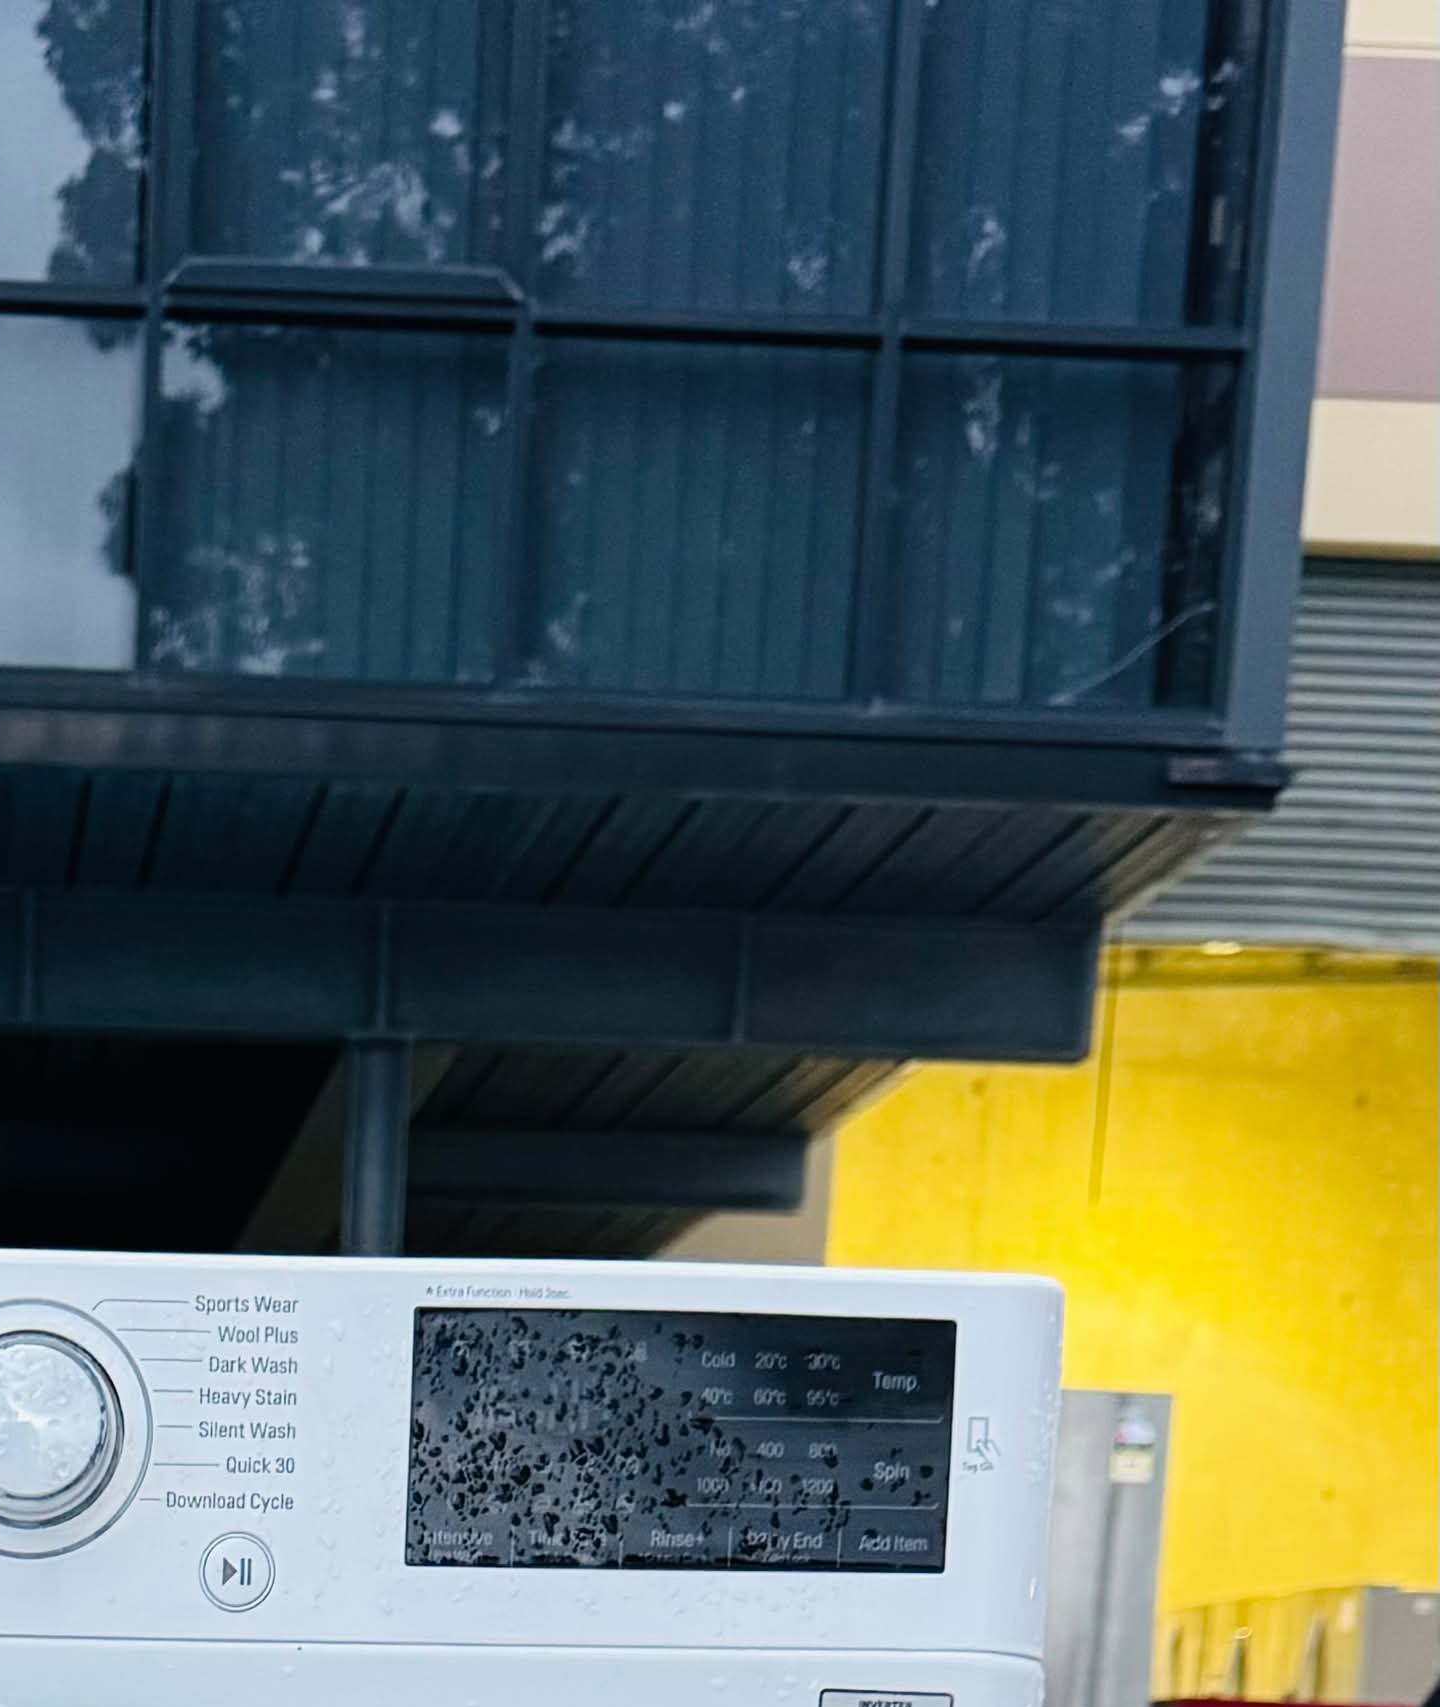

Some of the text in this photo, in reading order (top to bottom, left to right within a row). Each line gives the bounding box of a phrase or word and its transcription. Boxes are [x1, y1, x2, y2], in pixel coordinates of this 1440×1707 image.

[195, 1295, 300, 1317] Sports Wear
[218, 1326, 299, 1345] Wool Plus
[208, 1356, 299, 1375] Dark Wash
[701, 1351, 736, 1369] Cold
[873, 1370, 921, 1393] Temp.
[198, 1388, 298, 1409] Heavy Stain
[198, 1421, 297, 1440] Silent Wash
[226, 1456, 296, 1475] Quick 30
[873, 1461, 910, 1484] Spin
[166, 1491, 295, 1515] Download Cycle
[793, 1530, 822, 1550] End
[859, 1533, 929, 1551] Add Item
